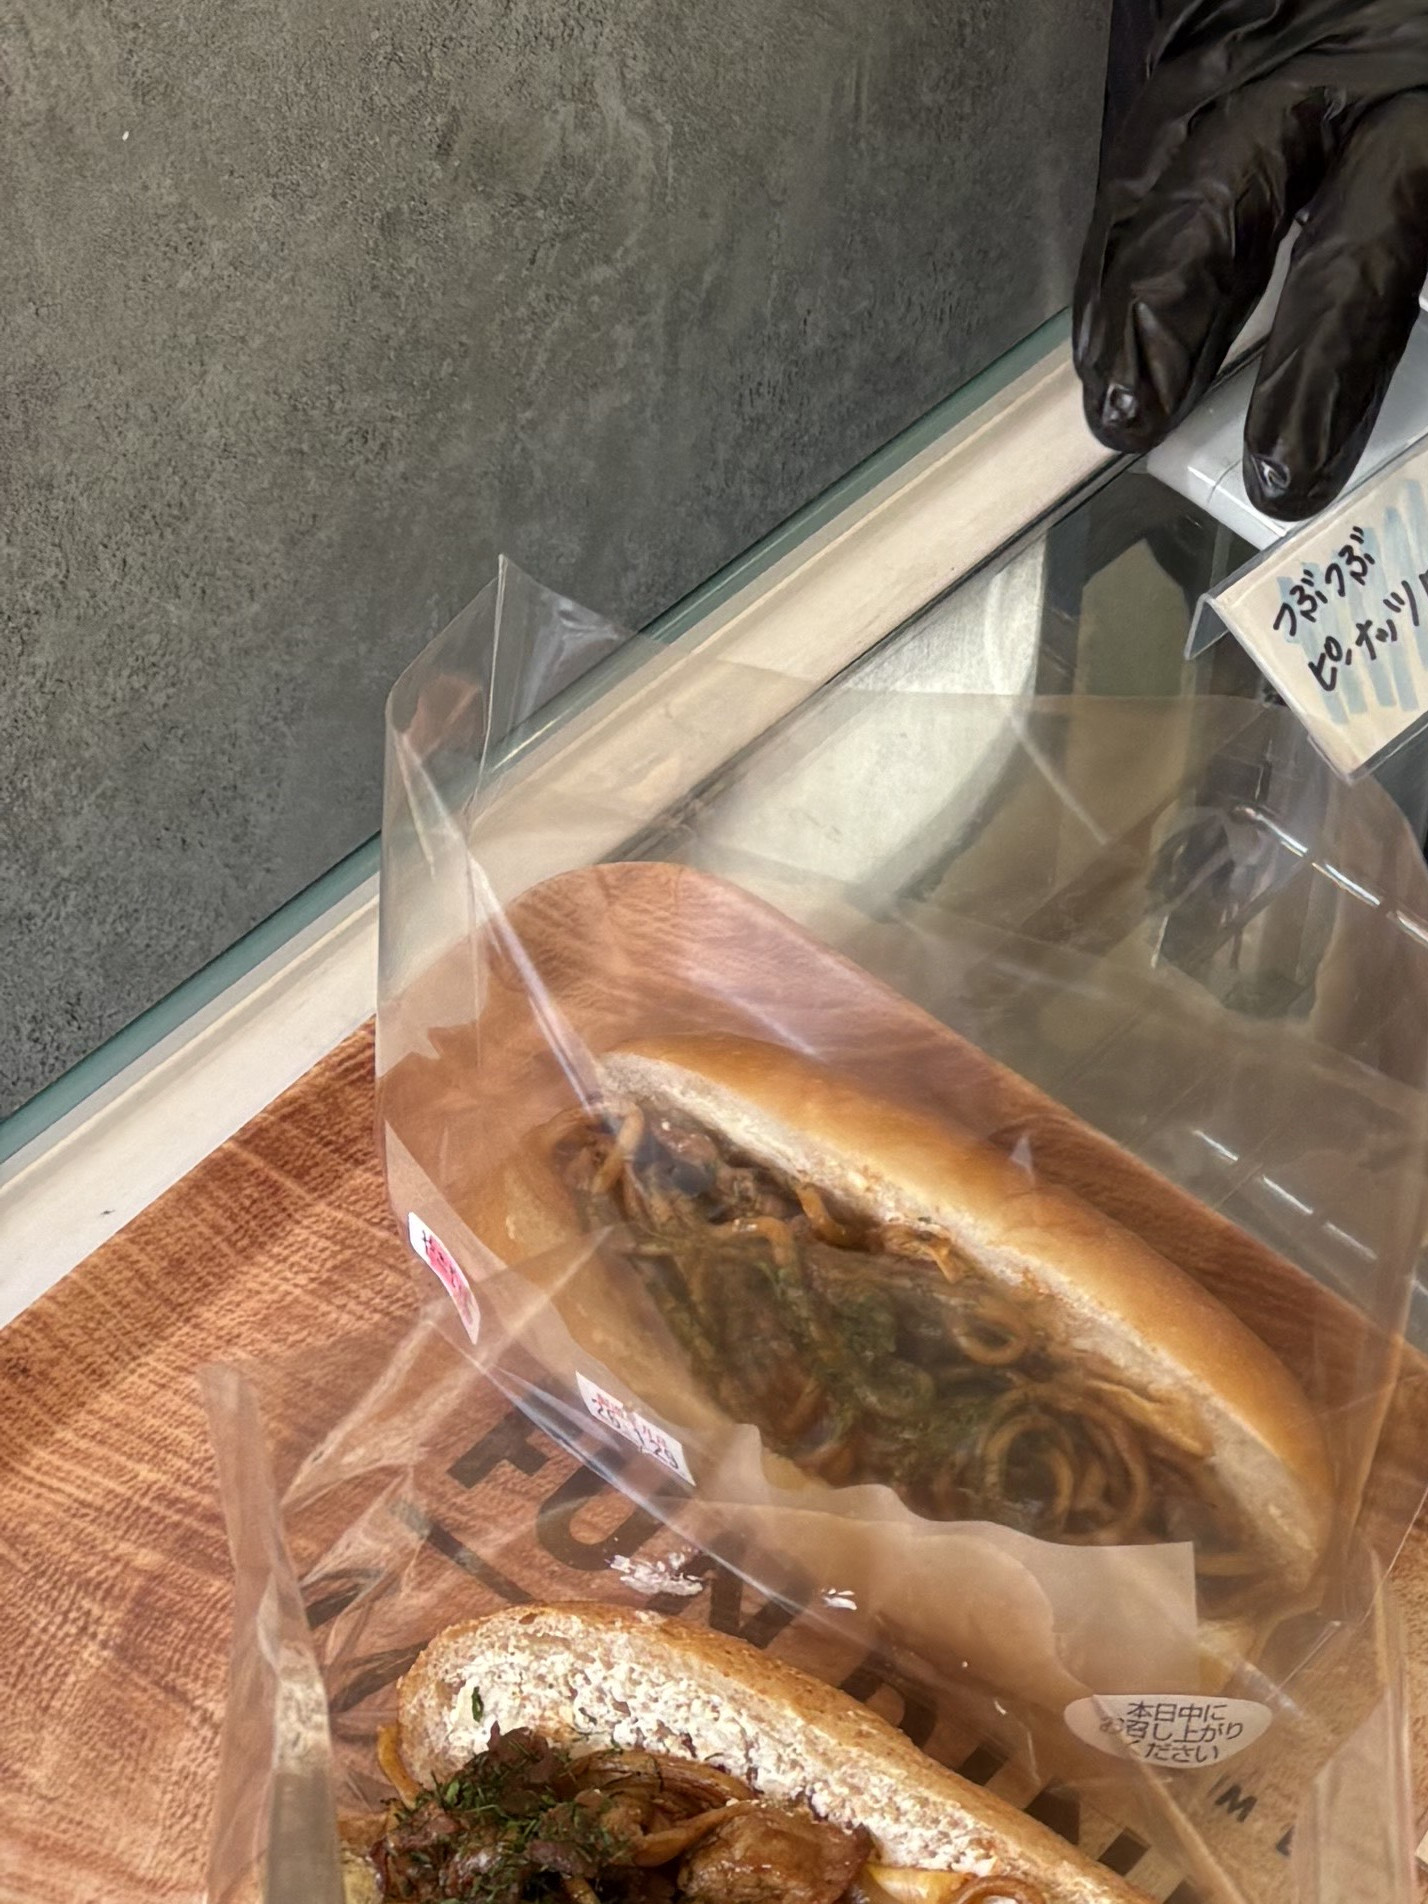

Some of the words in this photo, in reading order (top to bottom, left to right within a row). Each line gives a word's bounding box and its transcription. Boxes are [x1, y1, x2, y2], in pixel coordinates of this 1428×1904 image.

[1272, 524, 1377, 638] つぶつぶ
[1126, 1700, 1229, 1724] 本日中に
